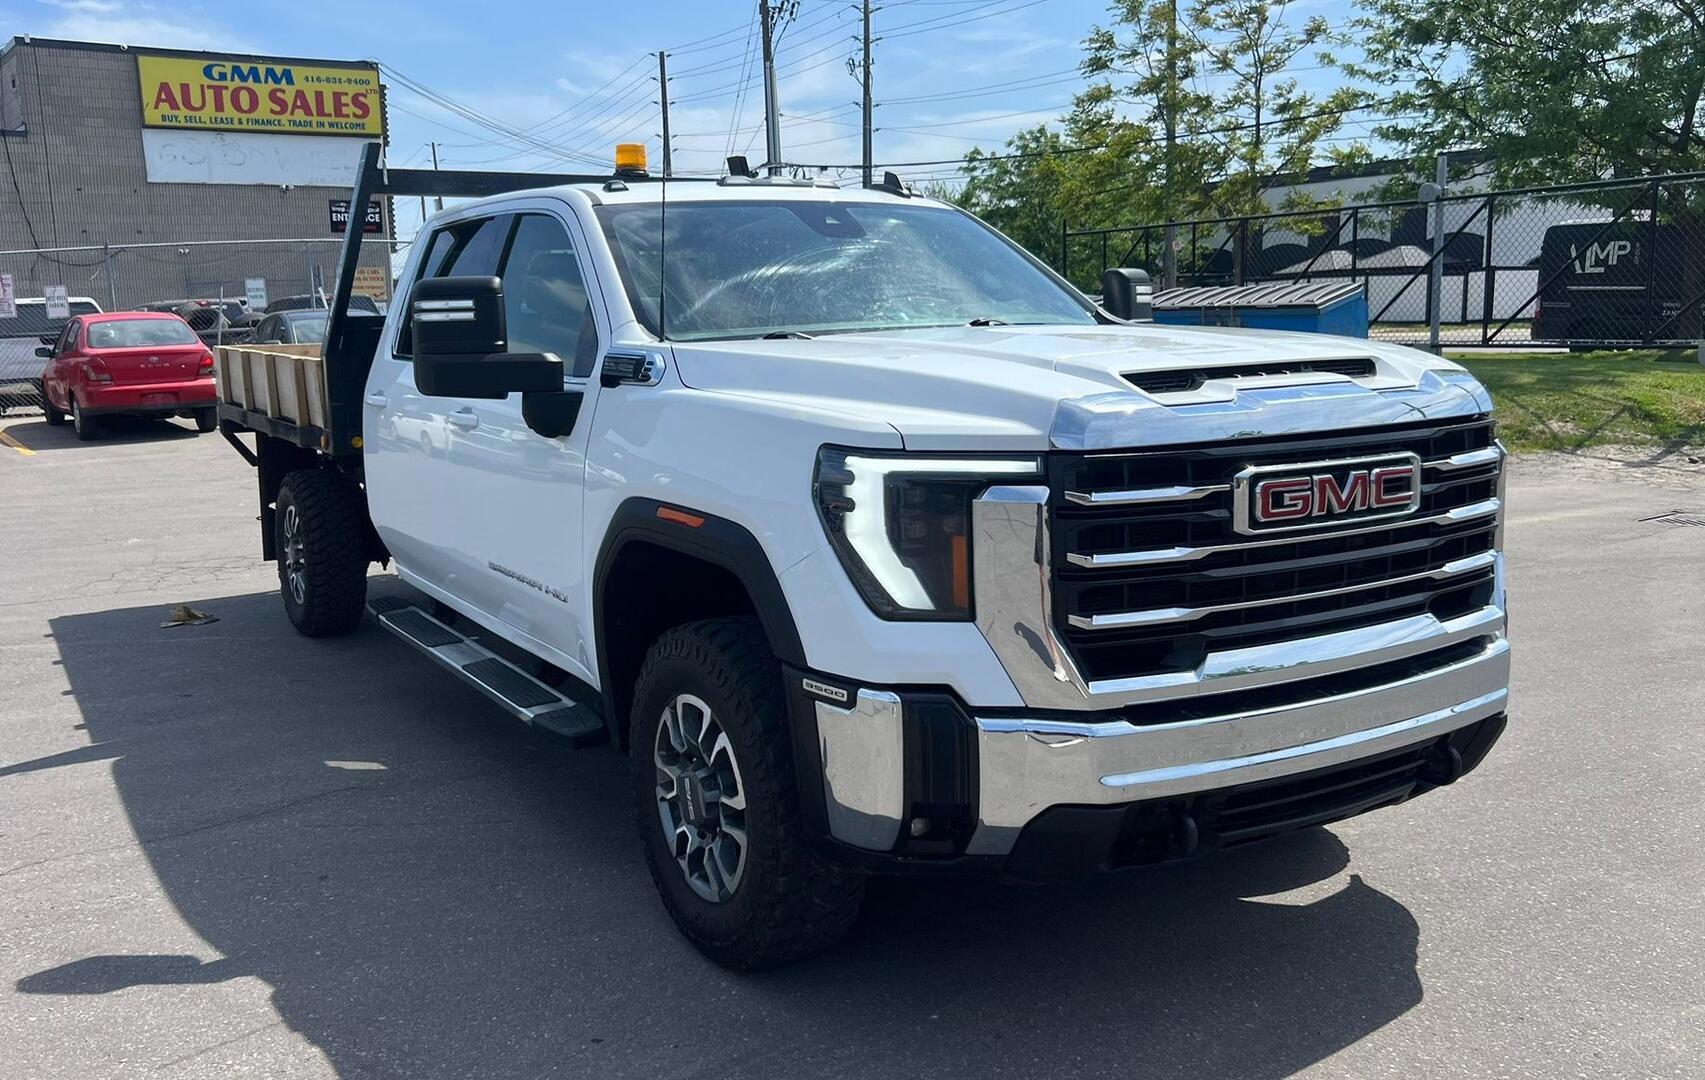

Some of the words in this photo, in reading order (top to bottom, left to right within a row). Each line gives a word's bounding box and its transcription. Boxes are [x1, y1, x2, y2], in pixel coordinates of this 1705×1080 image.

[202, 63, 295, 86] GMM
[153, 82, 260, 114] AUTO
[267, 88, 371, 120] SALES
[161, 113, 181, 124] BUY,
[183, 115, 207, 125] SELL,
[209, 116, 235, 125] LEASE
[287, 119, 313, 128] TRADE
[316, 120, 325, 129] IN
[327, 121, 366, 130] WELCOME
[332, 213, 380, 222] ENTCE
[1255, 465, 1415, 523] GMC
[804, 681, 845, 698] 3500
